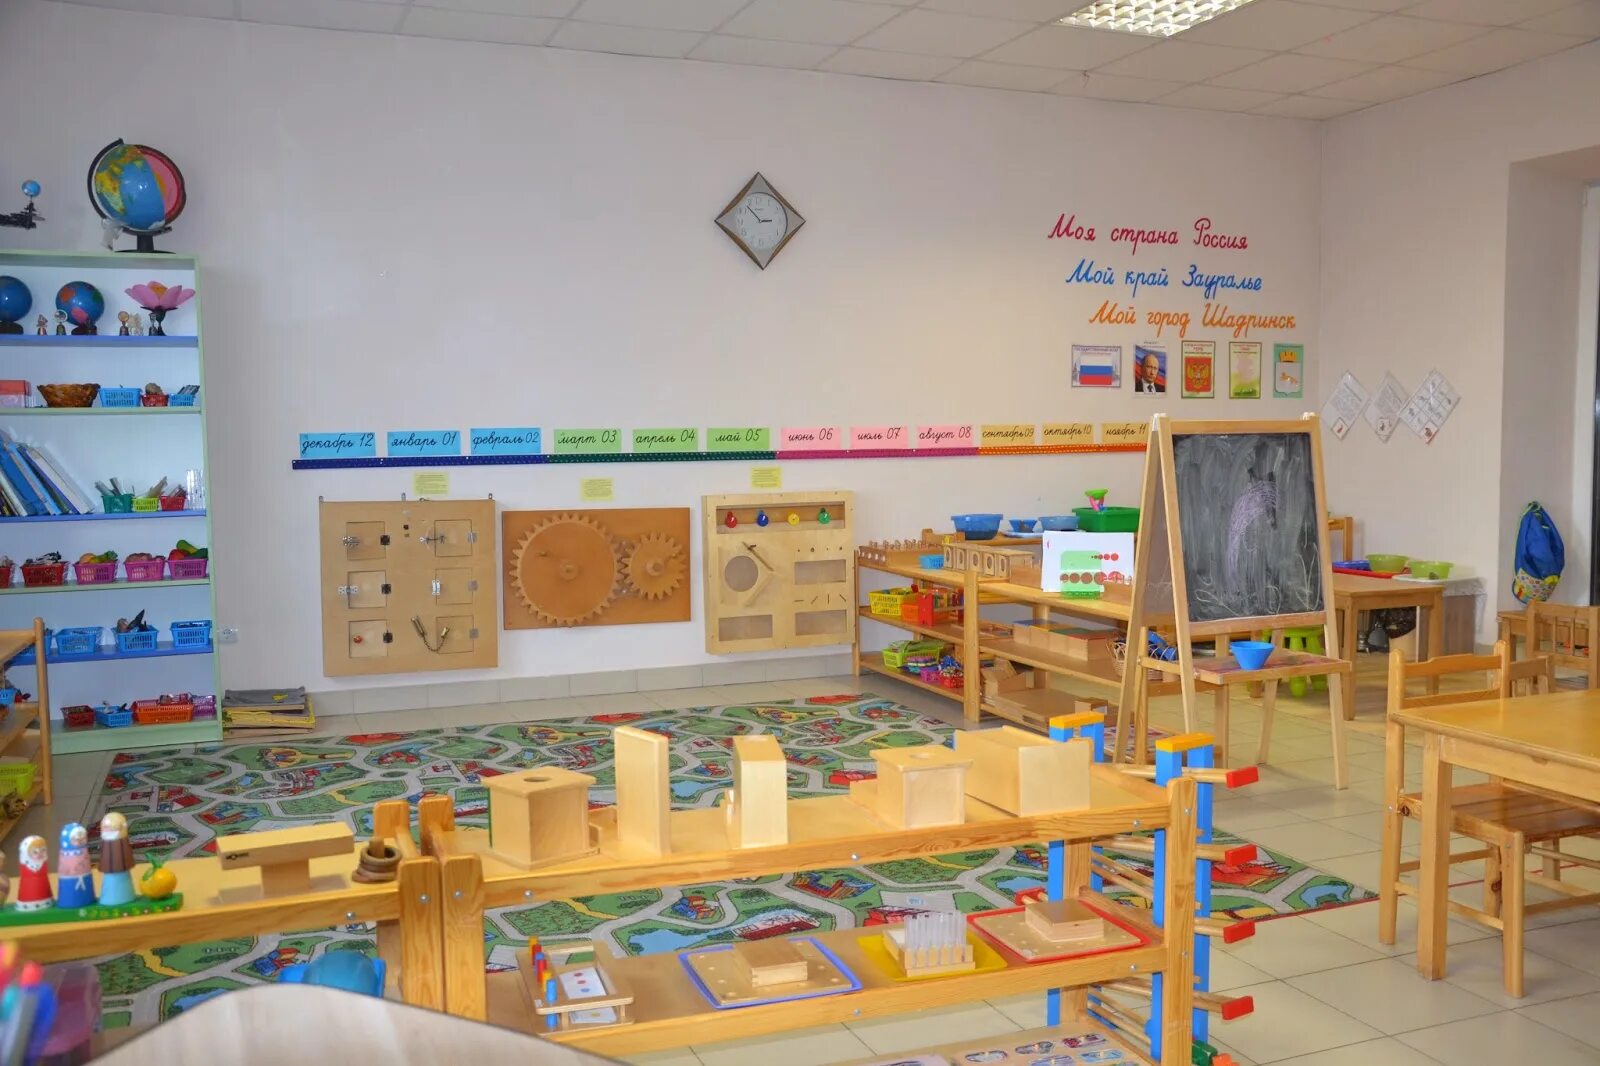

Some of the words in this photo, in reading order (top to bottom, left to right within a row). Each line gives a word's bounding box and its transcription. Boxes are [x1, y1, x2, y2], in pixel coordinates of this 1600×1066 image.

[1048, 213, 1096, 241] Моя
[1110, 227, 1178, 255] страна
[1193, 217, 1248, 250] Россия
[1065, 258, 1114, 285] Мой
[1124, 267, 1169, 298] край
[1182, 264, 1263, 300] Зауралье
[1088, 300, 1136, 325] Мой
[1147, 306, 1191, 338] город
[1202, 303, 1296, 338] Шадринск
[391, 431, 436, 451] январь
[442, 431, 457, 445] 01
[472, 428, 524, 449] февраль
[525, 432, 541, 443] 02
[557, 433, 597, 450] март
[601, 430, 617, 443] 03
[635, 435, 676, 450] апрель
[680, 429, 696, 443] 04
[715, 431, 741, 443] май
[745, 428, 762, 442] 05
[788, 429, 815, 442] июнь
[818, 428, 833, 441] 06
[857, 430, 883, 441] июль
[886, 428, 901, 440] 07
[918, 428, 955, 442] август
[957, 426, 972, 439] 08
[982, 426, 1023, 441] сентябрь
[1024, 427, 1036, 439] 09
[1043, 424, 1082, 440] октябрь
[1082, 424, 1093, 435] 10
[1105, 424, 1137, 439] ноябрь
[1138, 424, 1148, 435] 11
[301, 433, 353, 457] декабрь
[359, 433, 374, 447] 12
